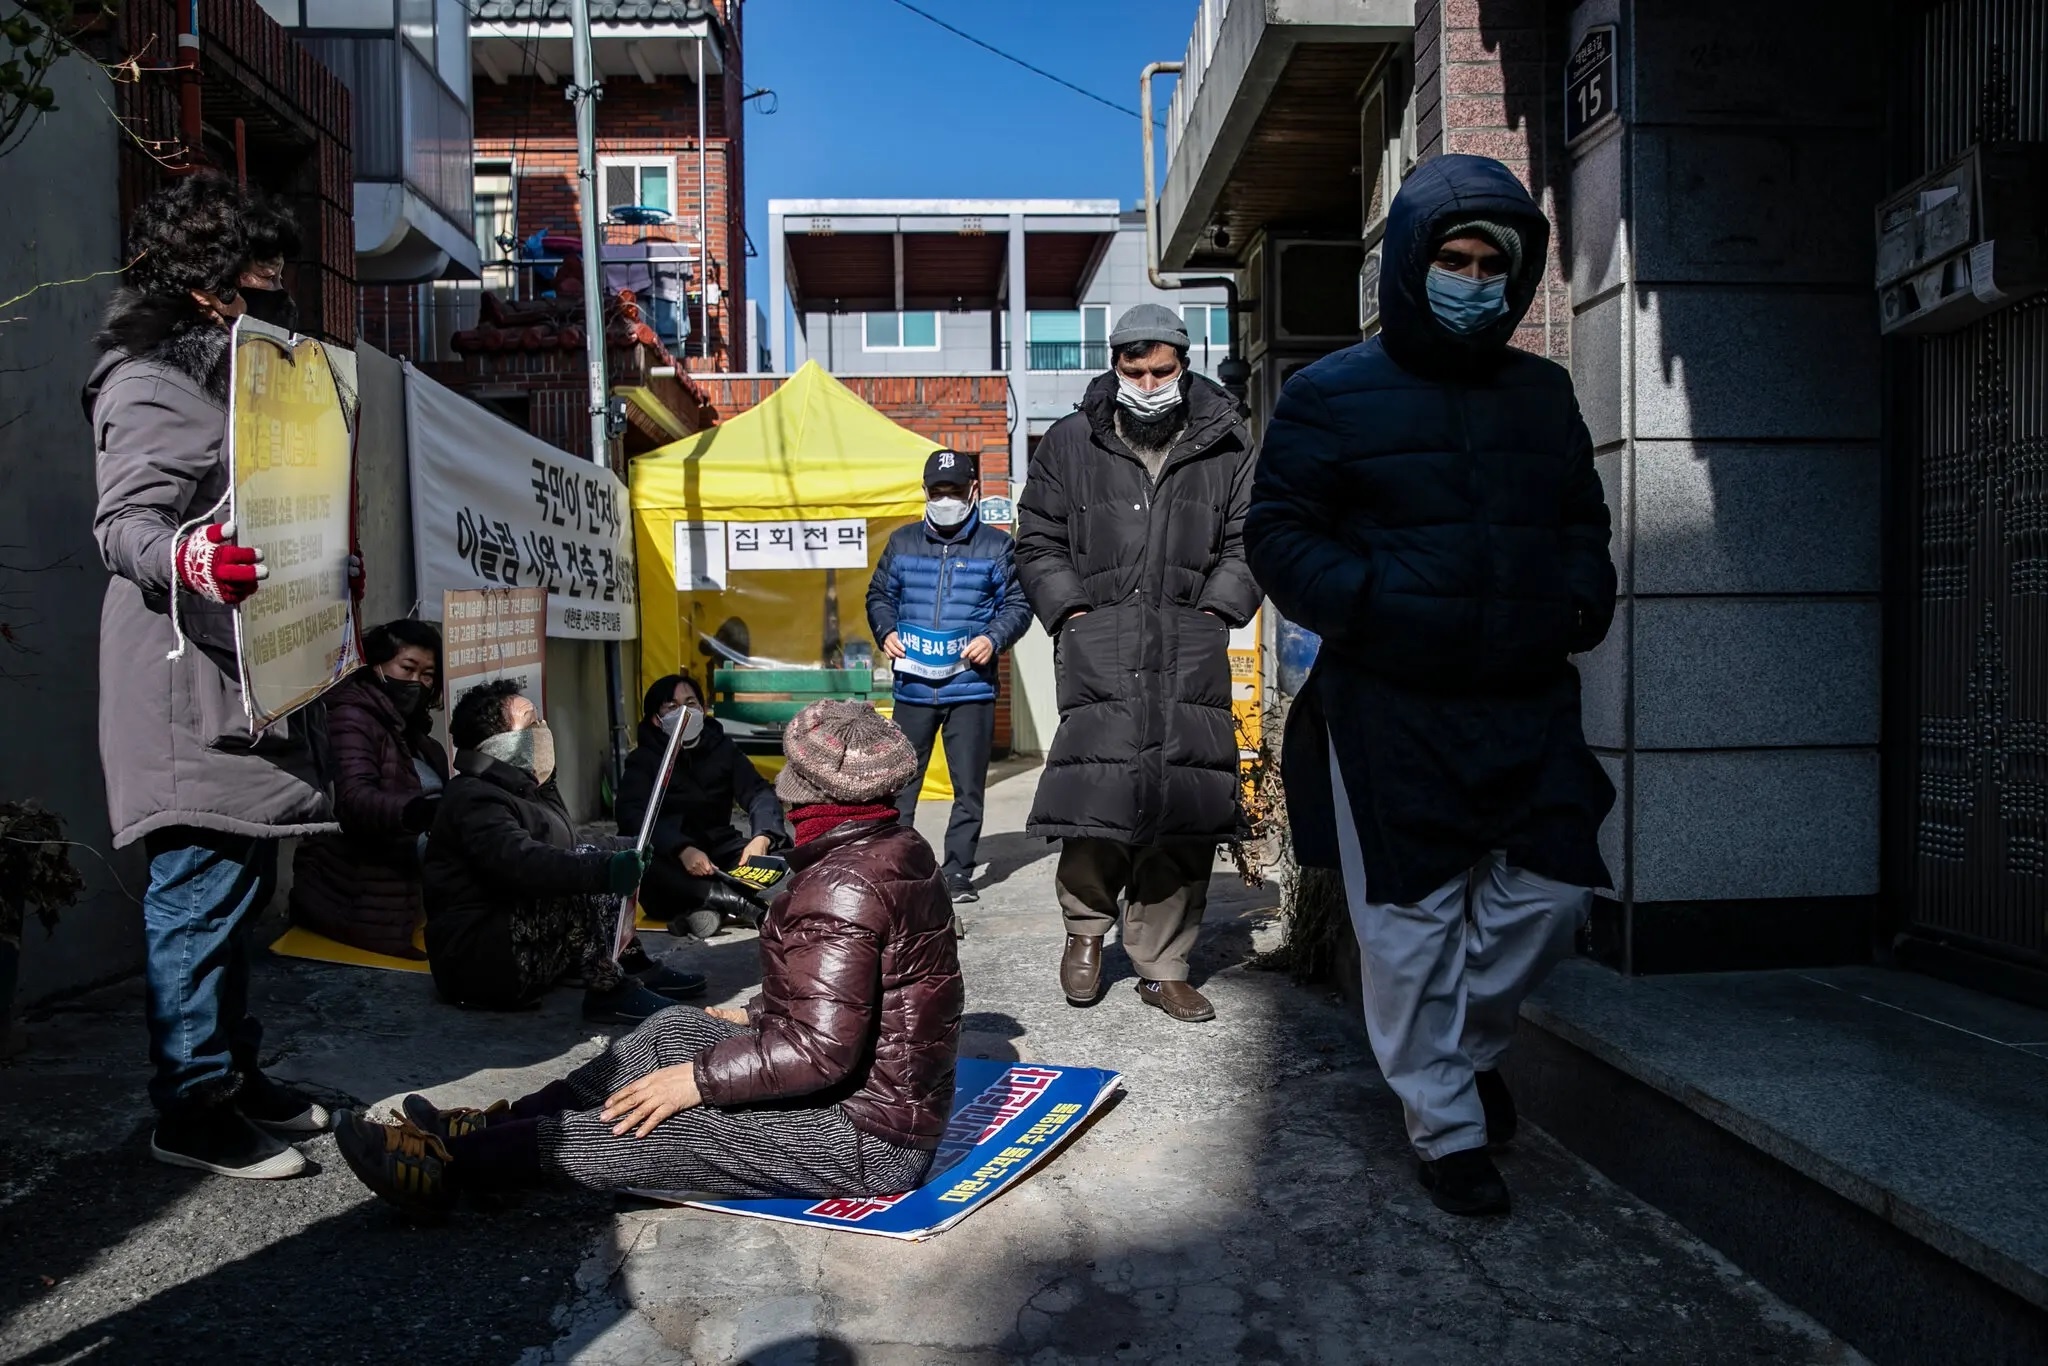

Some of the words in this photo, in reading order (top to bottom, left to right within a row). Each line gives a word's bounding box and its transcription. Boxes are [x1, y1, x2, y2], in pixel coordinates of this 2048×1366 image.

[1578, 73, 1601, 123] 15
[938, 452, 955, 471] B
[531, 458, 582, 531] 국민이
[983, 509, 1010, 521] 15-5
[457, 506, 520, 587] 이슬람
[561, 541, 598, 600] 건축
[903, 632, 920, 652] 사원
[922, 638, 945, 657] 공사
[946, 635, 968, 656] 중지
[1015, 1103, 1083, 1145] 주민일동
